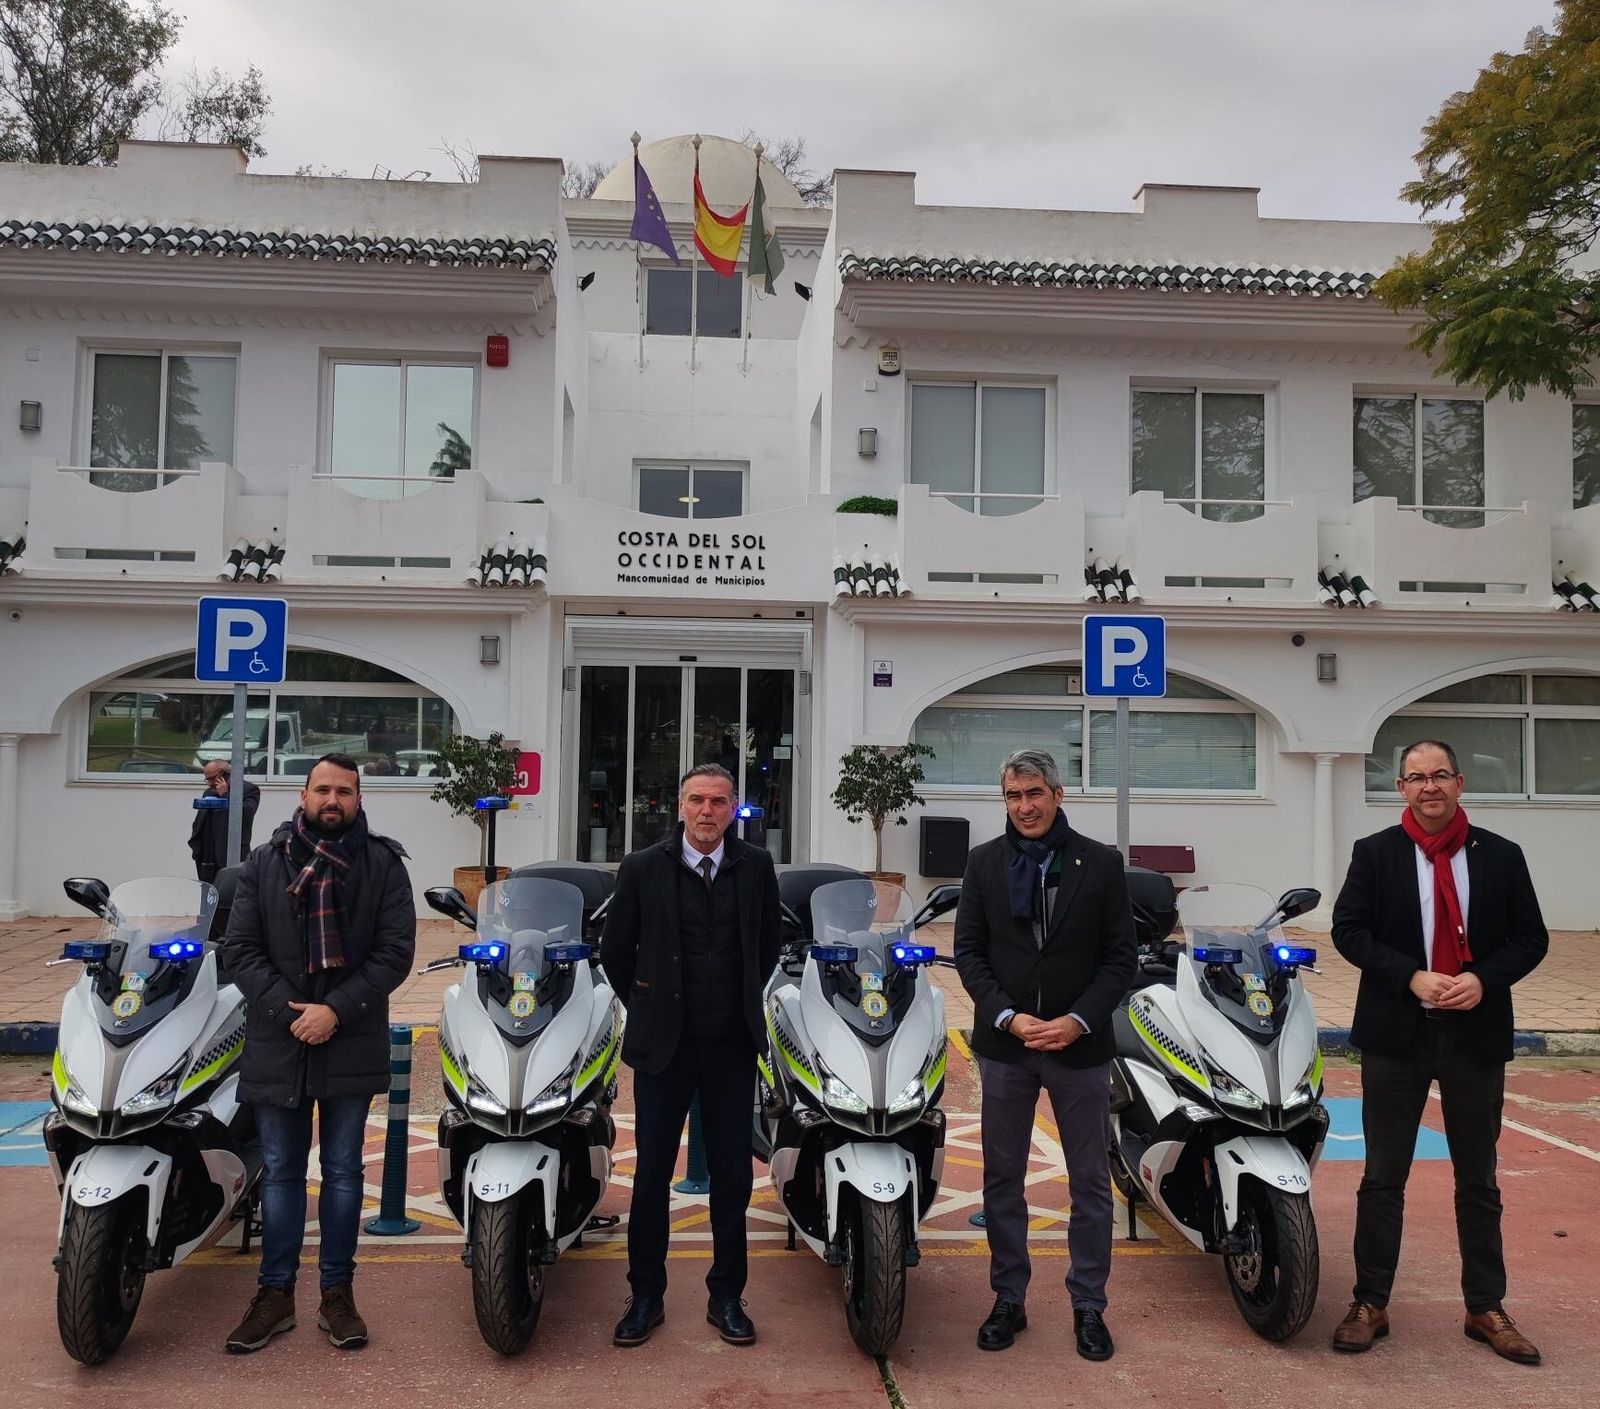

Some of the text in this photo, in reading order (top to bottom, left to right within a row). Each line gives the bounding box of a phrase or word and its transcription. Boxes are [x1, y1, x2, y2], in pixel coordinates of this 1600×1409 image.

[618, 531, 766, 550] COSTA DEL SOL
[618, 552, 766, 571] OCCIDENTAL
[617, 573, 766, 587] Mancomunidad de Municipios
[214, 607, 267, 672] P
[1101, 625, 1149, 687] P
[1277, 1174, 1307, 1187] S-10
[77, 1186, 112, 1199] S-12
[481, 1182, 510, 1196] S-11
[872, 1182, 896, 1194] S-9
